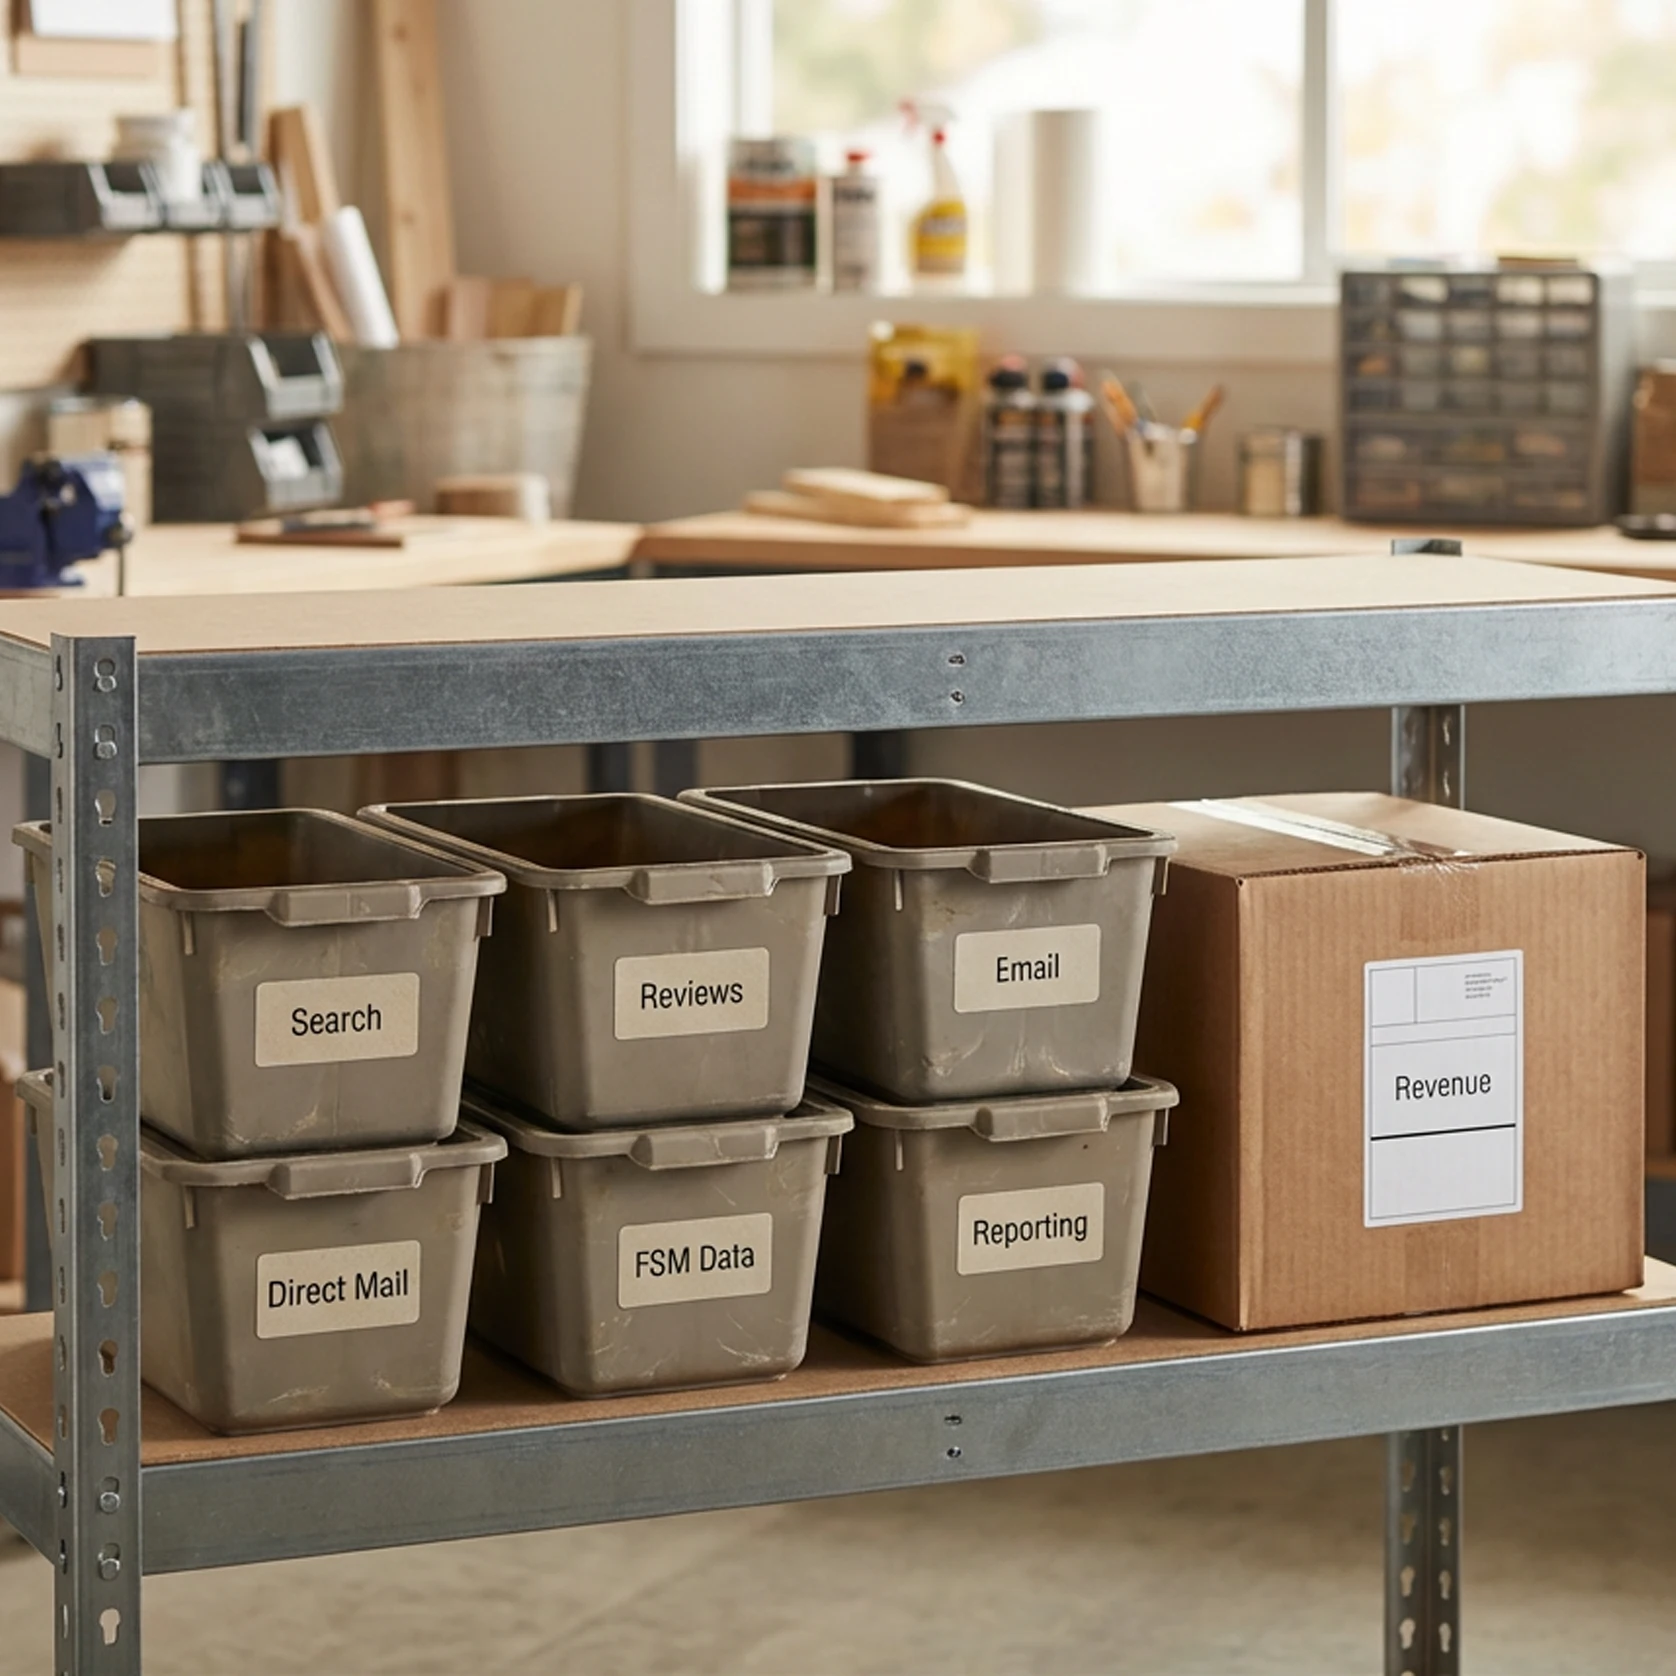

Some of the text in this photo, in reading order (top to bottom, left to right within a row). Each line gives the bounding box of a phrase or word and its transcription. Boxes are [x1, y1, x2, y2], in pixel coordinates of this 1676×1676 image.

[996, 953, 1059, 983] Email
[641, 980, 743, 1010] Reviews
[291, 1003, 381, 1036] Search
[1395, 1073, 1491, 1101] Revenue
[973, 1212, 1088, 1249] Reporting
[636, 1244, 755, 1278] FSM Data
[268, 1268, 407, 1308] Direct Mail
